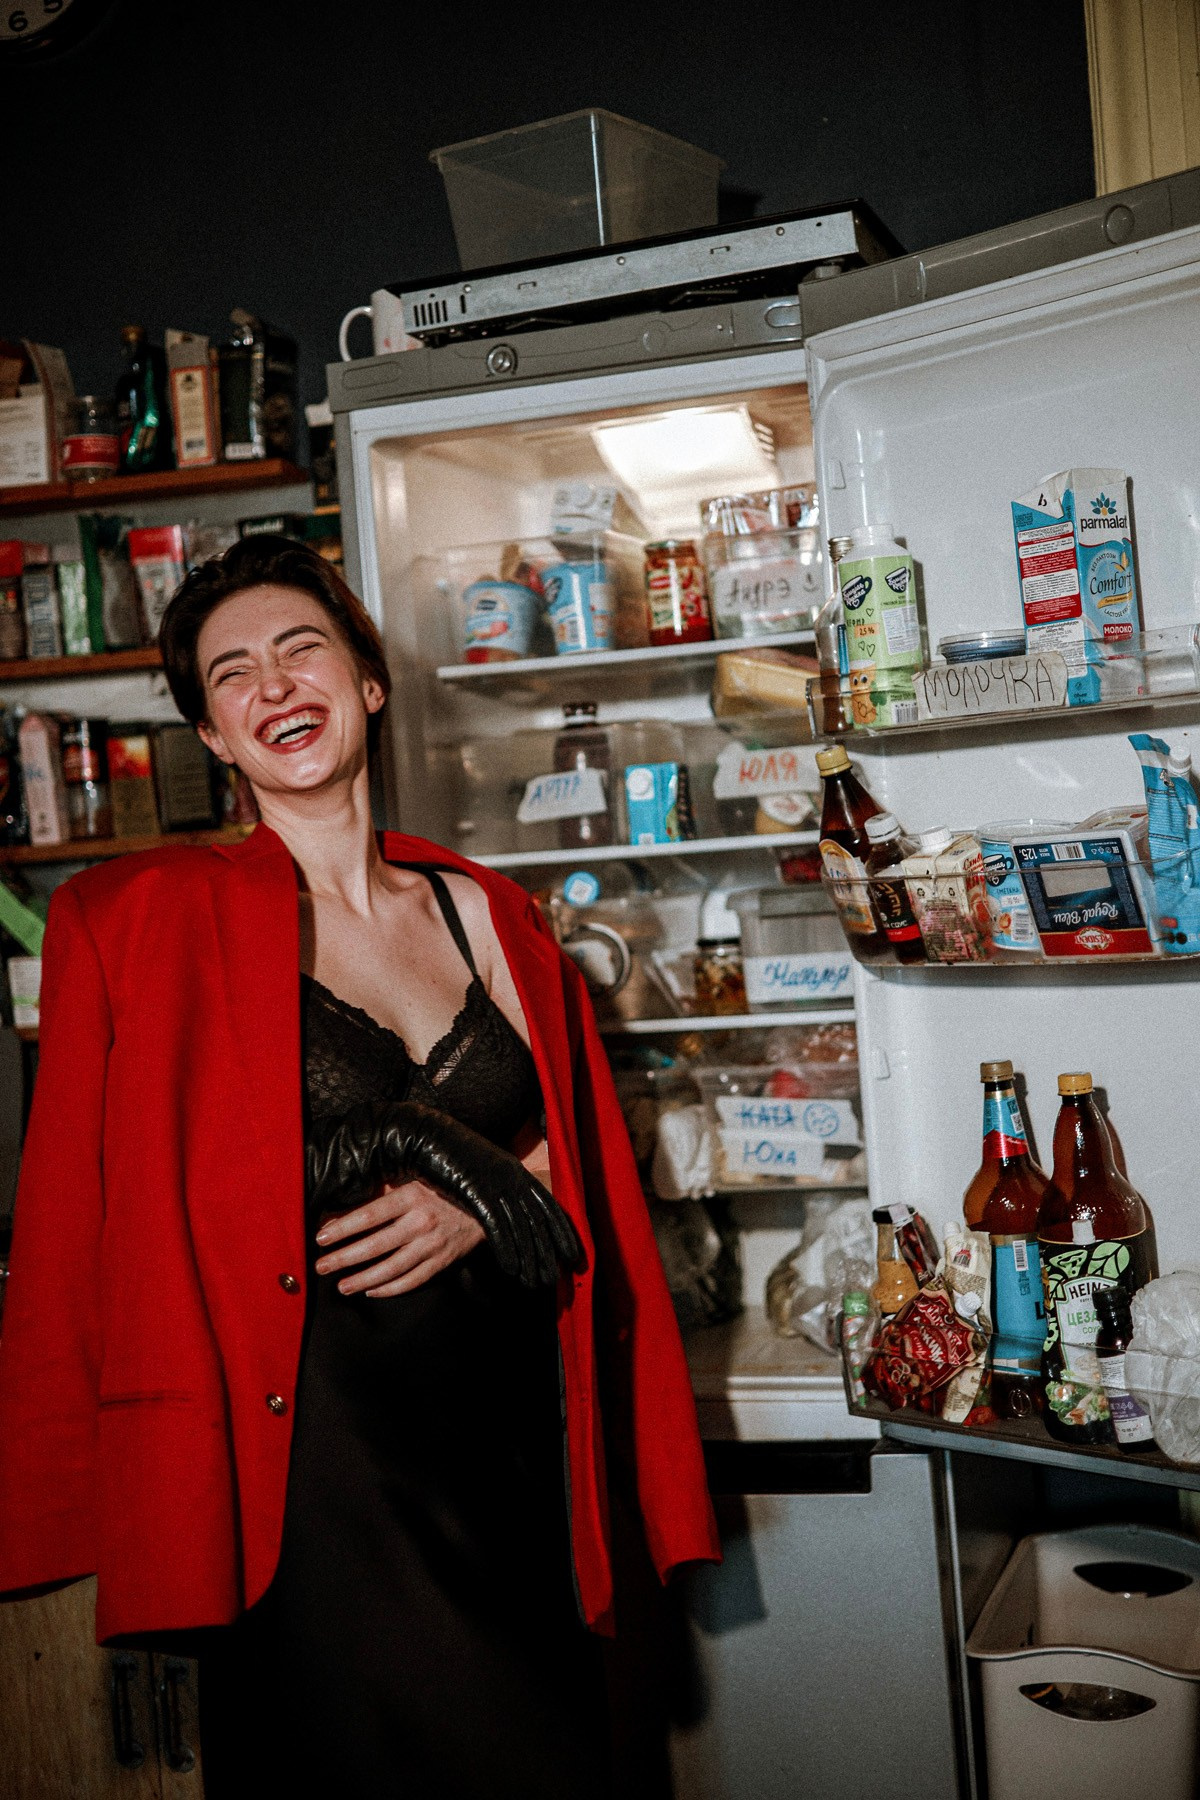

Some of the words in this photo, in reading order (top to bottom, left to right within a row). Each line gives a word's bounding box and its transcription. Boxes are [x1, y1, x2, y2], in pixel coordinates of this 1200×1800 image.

[8, 10, 28, 32] 6
[1080, 515, 1128, 533] parmalat
[1089, 571, 1132, 595] Comfort
[1103, 625, 1133, 635] МОЛОКО
[923, 658, 1055, 714] МОЛОЧКА
[738, 751, 799, 783] ЮЛЯ
[1021, 847, 1038, 861] 125
[1053, 909, 1082, 925] Bleu
[1082, 902, 1119, 922] Royal
